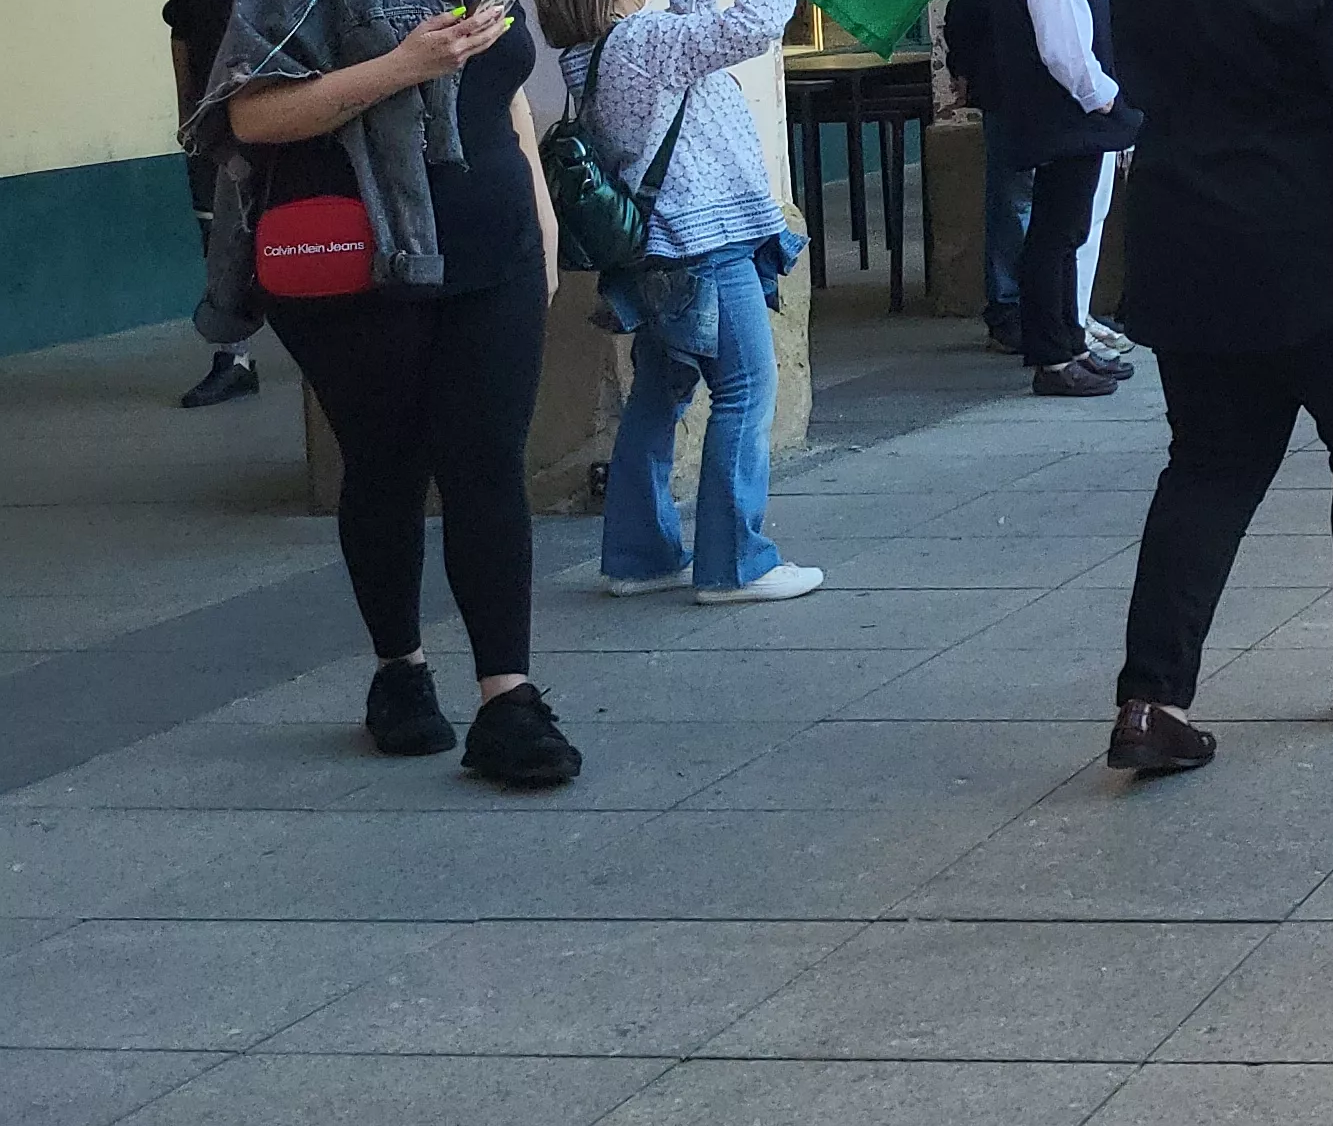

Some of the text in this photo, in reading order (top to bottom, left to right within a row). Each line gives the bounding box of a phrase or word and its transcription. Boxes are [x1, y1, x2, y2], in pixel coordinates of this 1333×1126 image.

[263, 241, 365, 257] Calvin Klein Jeans
